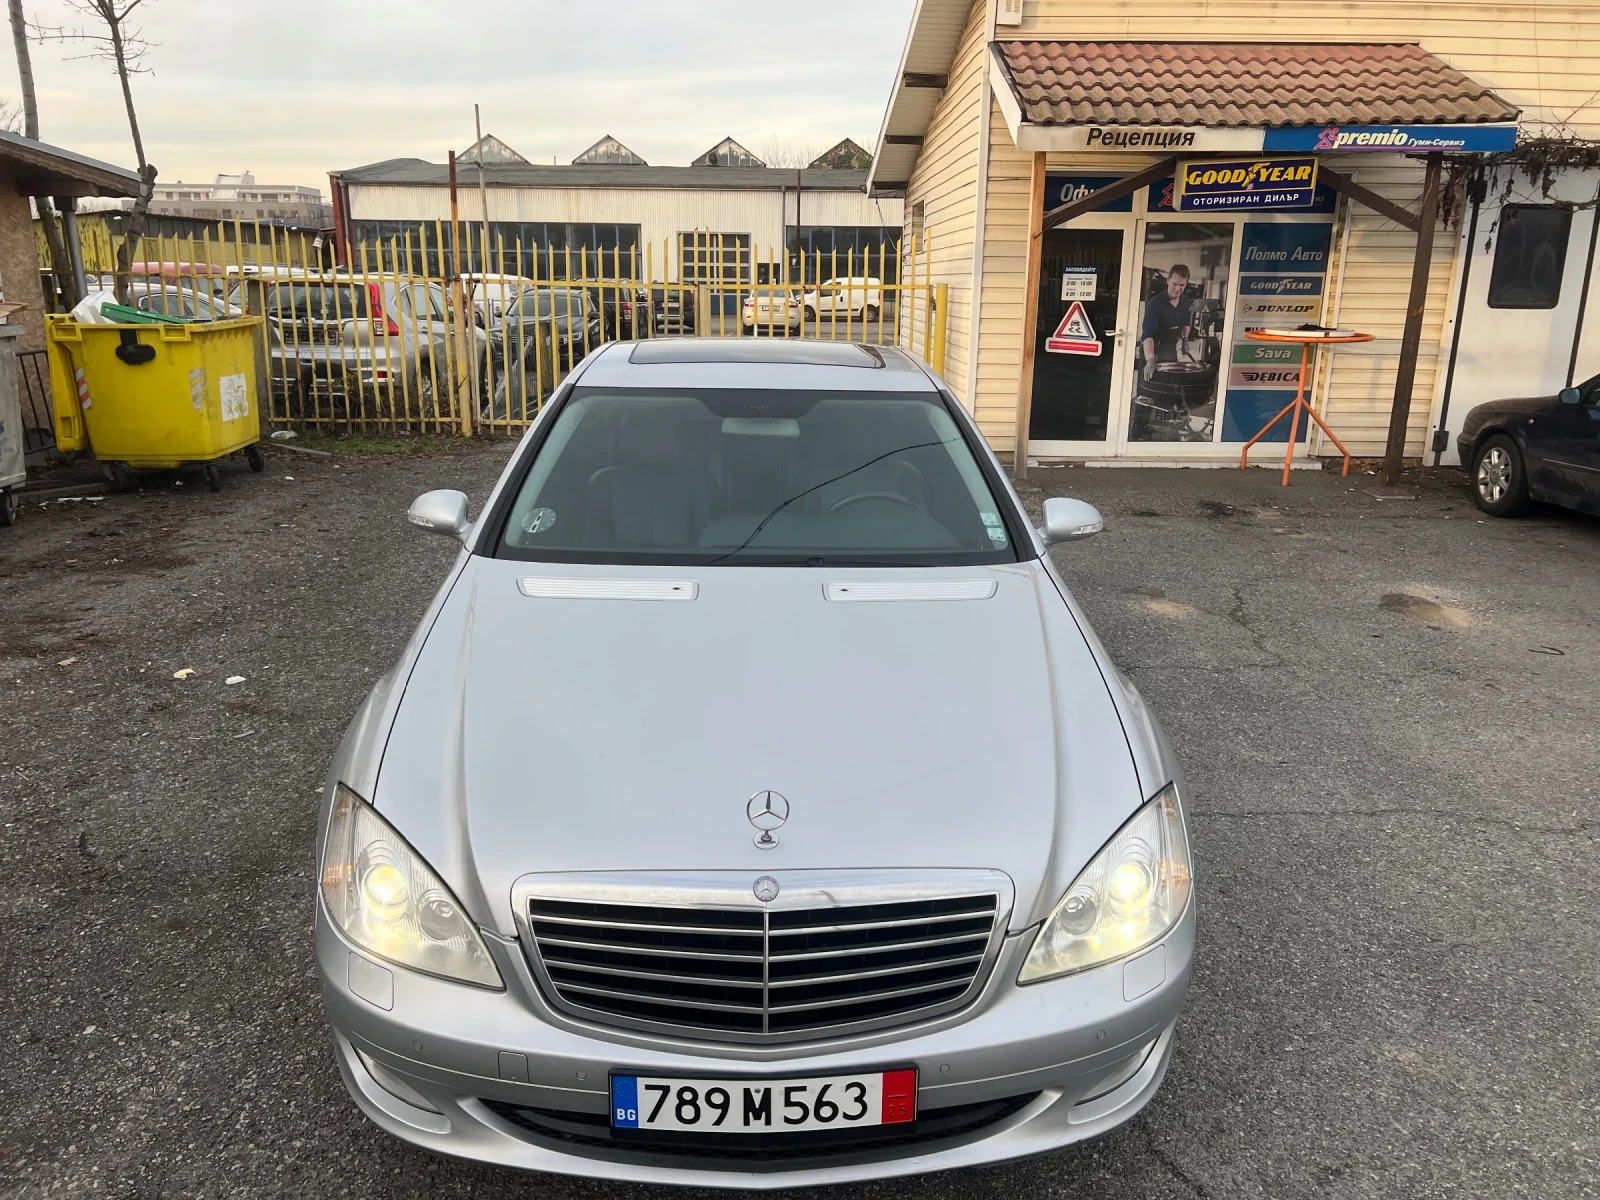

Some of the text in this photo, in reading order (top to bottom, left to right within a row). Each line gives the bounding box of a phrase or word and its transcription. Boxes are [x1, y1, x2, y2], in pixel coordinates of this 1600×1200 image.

[1086, 127, 1196, 148] Рецепция
[1332, 129, 1409, 149] premio
[1408, 138, 1466, 147] Гуми-Сервиз
[1060, 183, 1095, 201] Оф
[1192, 193, 1300, 206] ОТОРИЗИРАН ДИЛЪР
[1245, 246, 1323, 261] Полмо Авто
[1254, 347, 1292, 359] Sava
[616, 1108, 636, 1121] BG
[644, 1083, 731, 1126] 789
[783, 1081, 868, 1125] 563
[887, 1103, 908, 1118] 25
